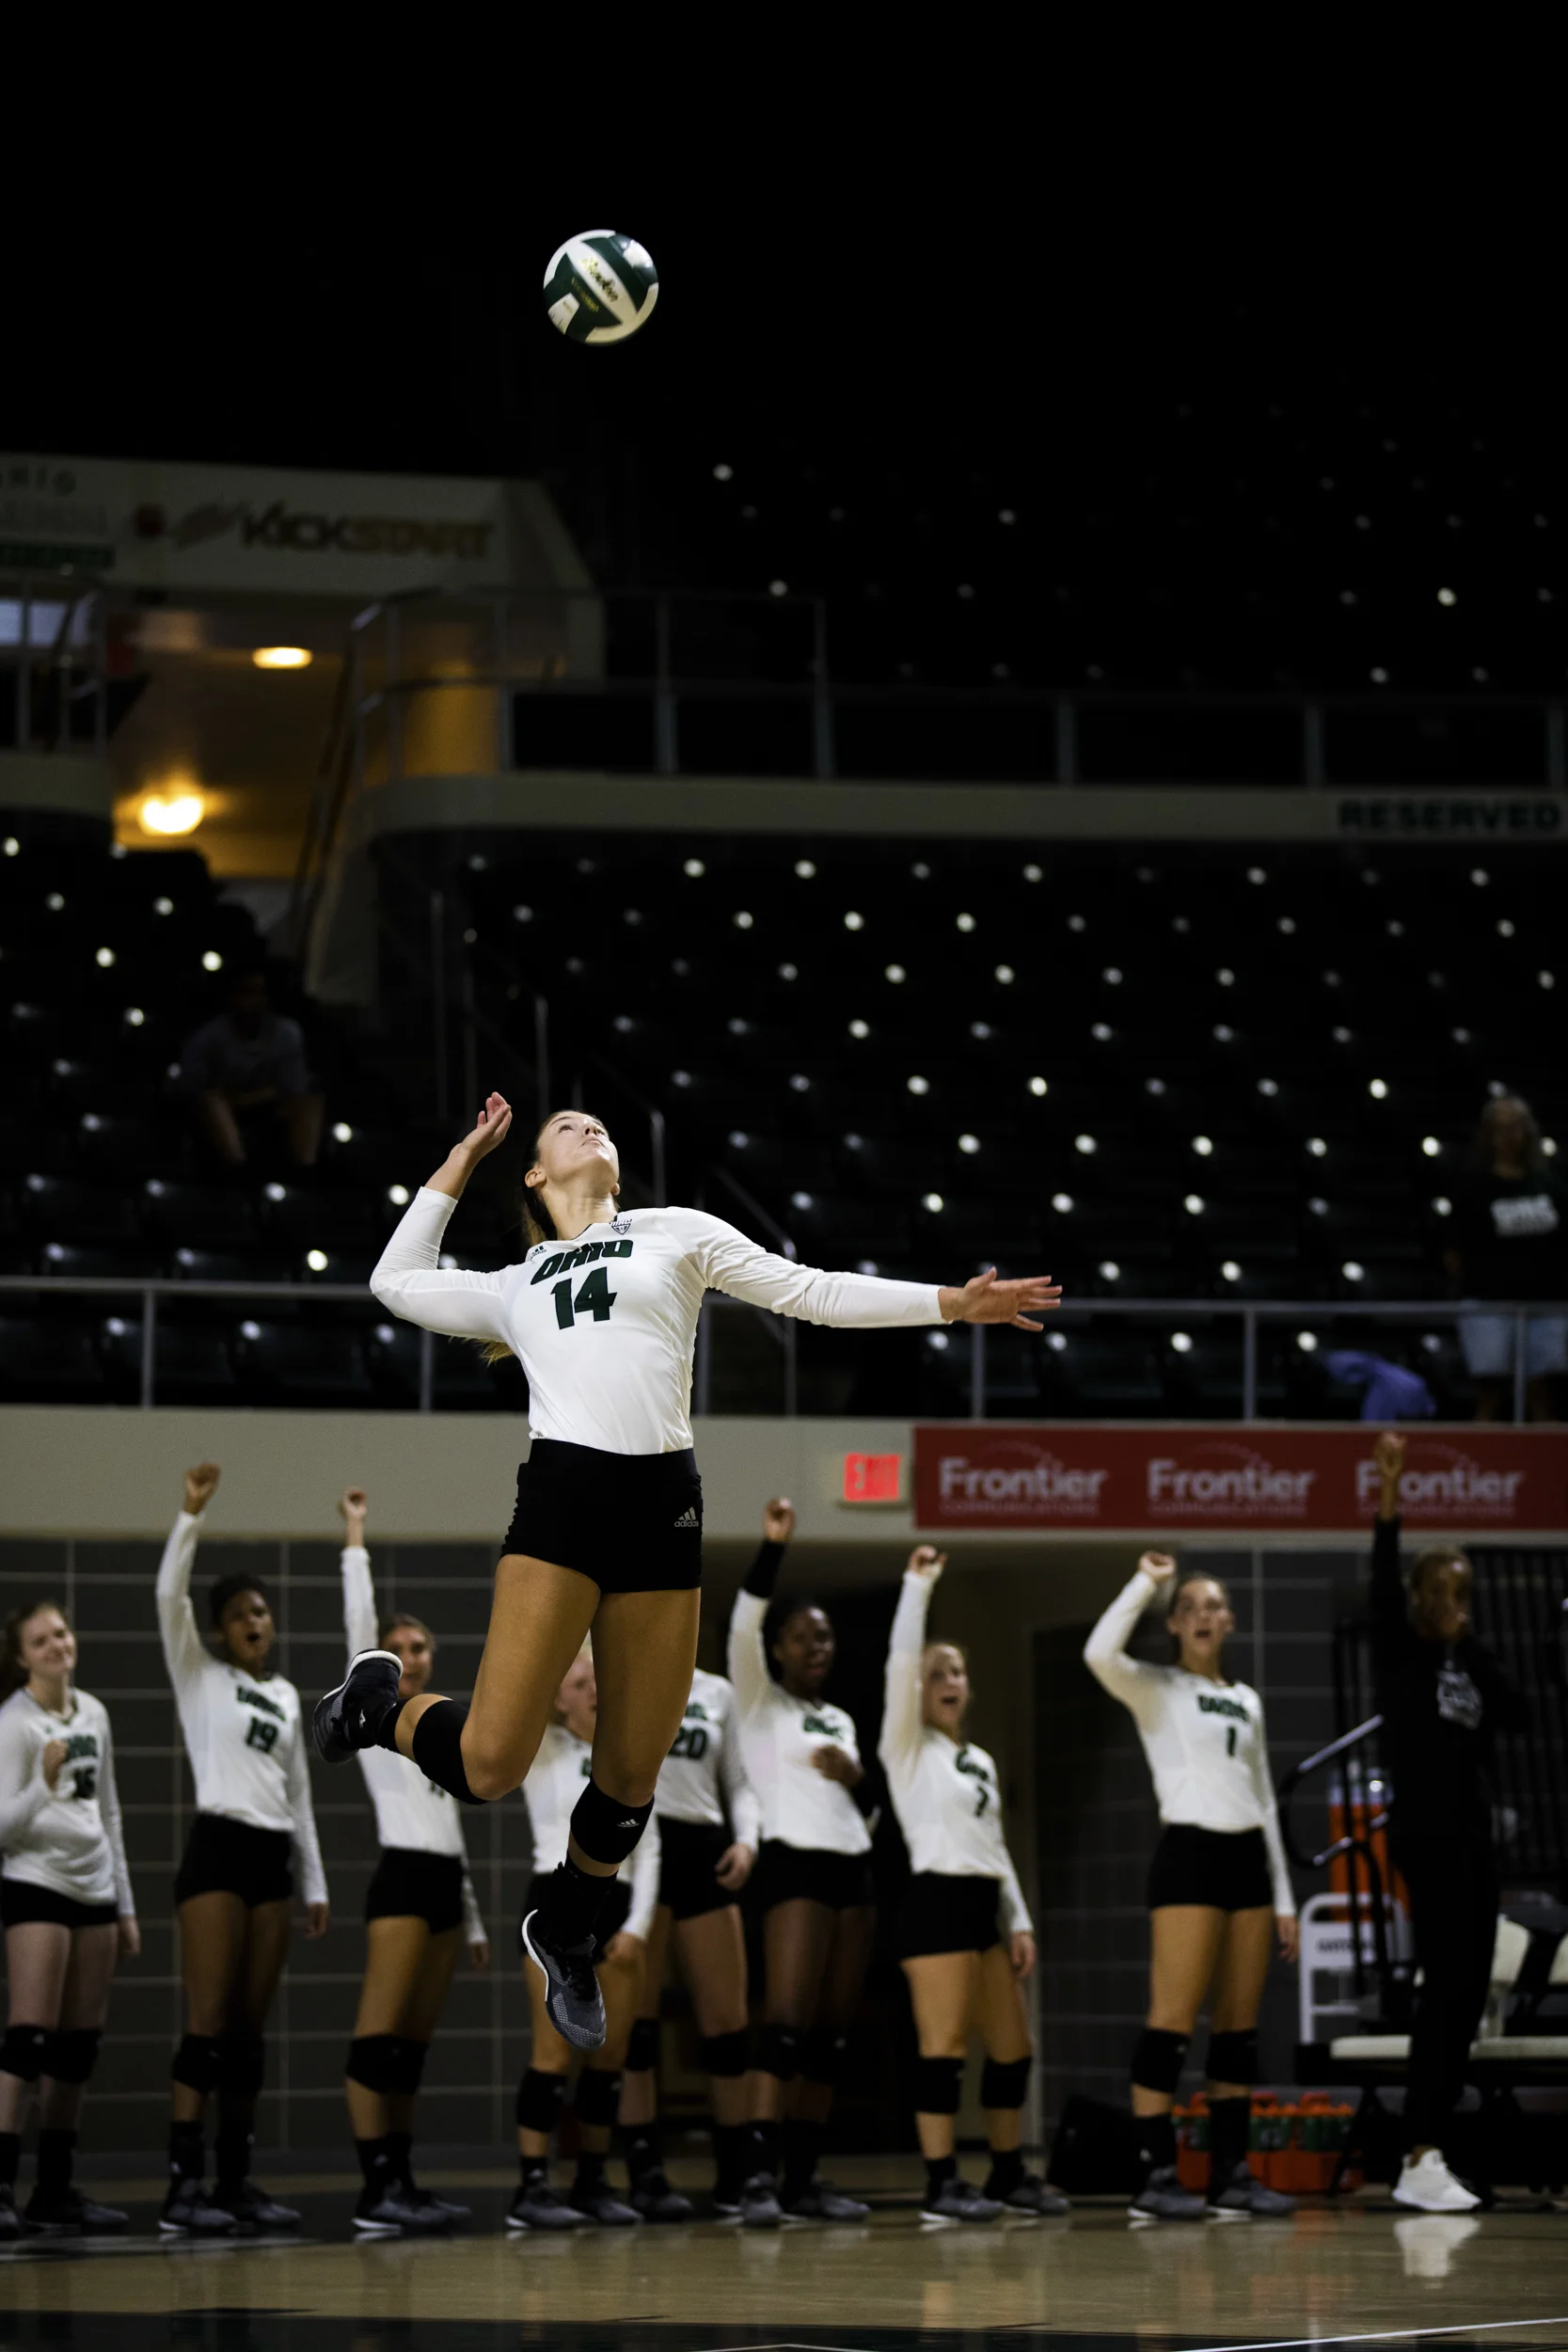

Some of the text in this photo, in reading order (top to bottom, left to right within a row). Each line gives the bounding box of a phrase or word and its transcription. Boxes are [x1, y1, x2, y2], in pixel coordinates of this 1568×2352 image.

[1339, 802, 1561, 830] RESERVED
[531, 1239, 634, 1285] OHIO
[550, 1266, 618, 1330] 14
[939, 1457, 1110, 1501] Frontier
[1147, 1457, 1317, 1502] Frontier
[1355, 1459, 1527, 1502] Fontier
[246, 1717, 278, 1754] 19
[1227, 1726, 1236, 1757] 1
[974, 1786, 990, 1817] 7
